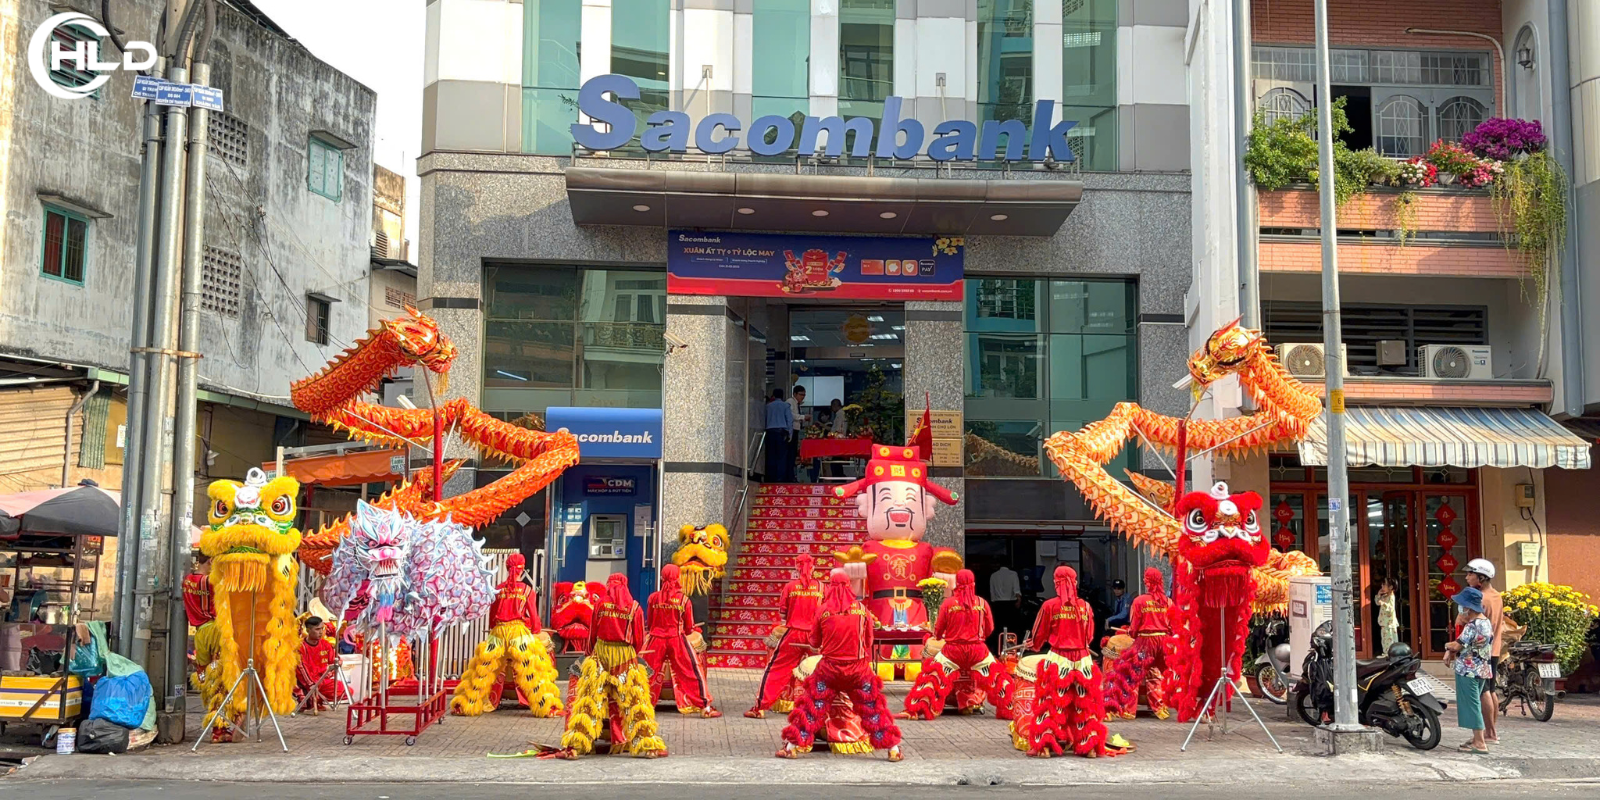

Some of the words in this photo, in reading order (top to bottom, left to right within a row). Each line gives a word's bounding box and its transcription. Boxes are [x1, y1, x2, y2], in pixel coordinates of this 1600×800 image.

[570, 74, 1079, 163] Sacombank
[679, 234, 721, 243] Sacombank
[683, 246, 705, 255] XUÂN
[742, 249, 758, 257] LỘC
[557, 427, 653, 443] acombank
[608, 479, 632, 487] CDM
